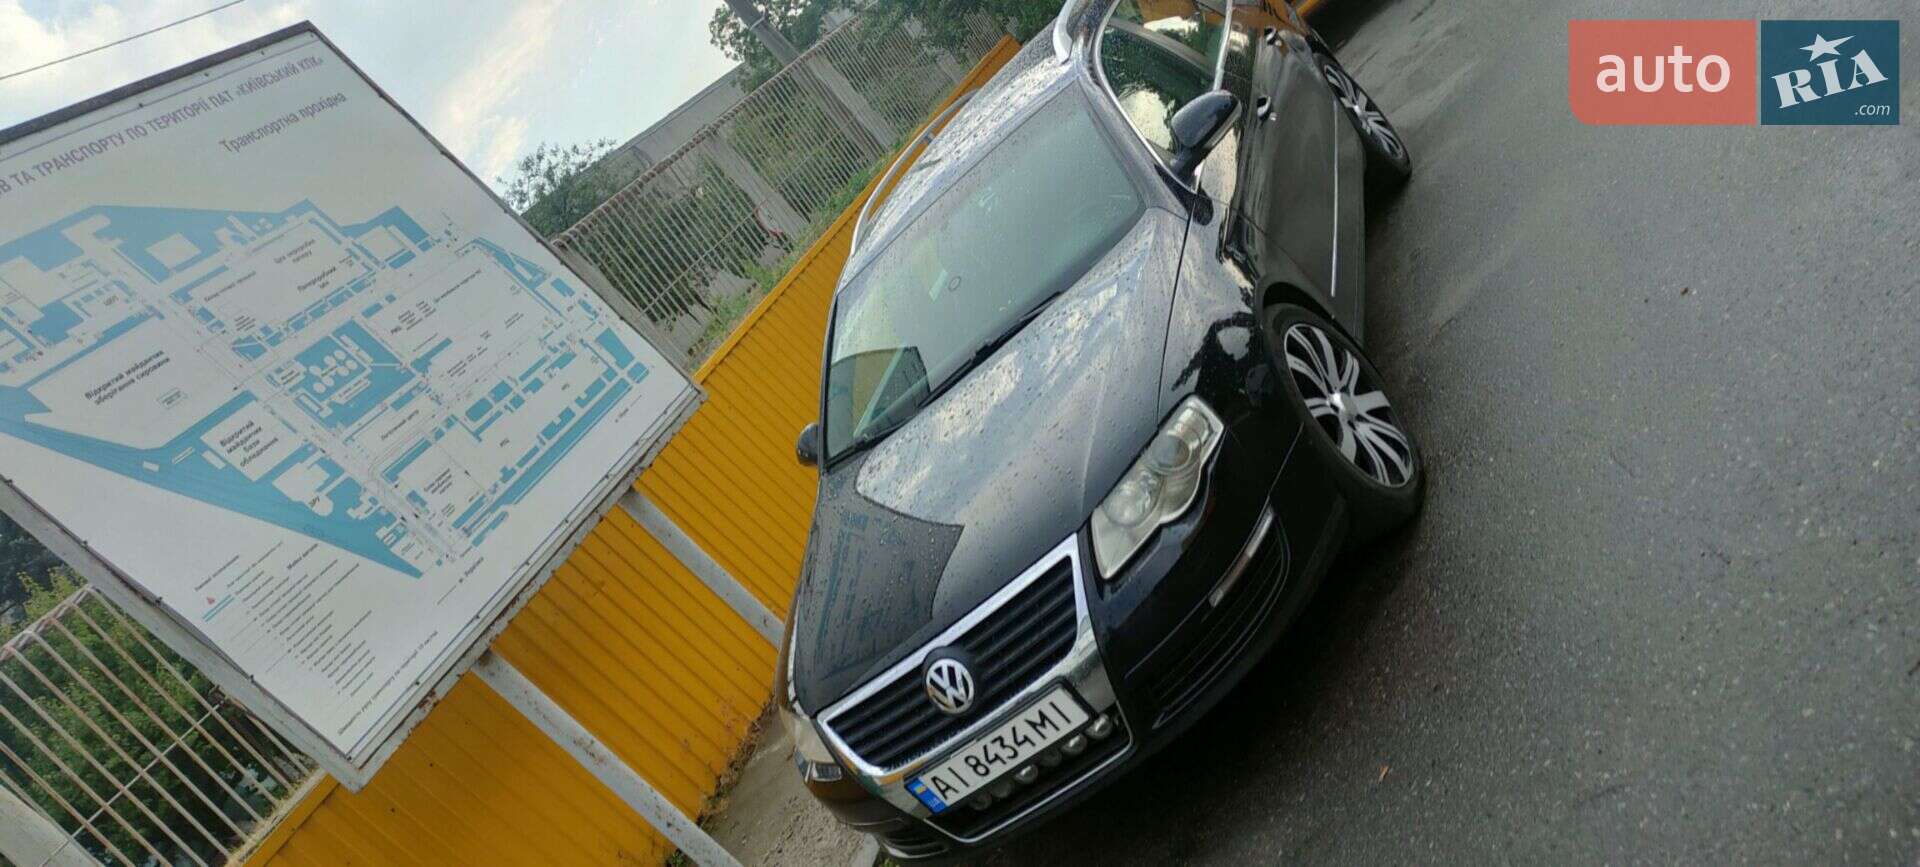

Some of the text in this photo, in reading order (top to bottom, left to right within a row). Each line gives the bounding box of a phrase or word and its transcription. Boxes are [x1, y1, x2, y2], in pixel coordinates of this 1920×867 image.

[9, 169, 36, 187] ТА
[31, 131, 125, 177] ТРАНСПОРТУ
[124, 124, 149, 142] ПО
[145, 97, 211, 134] ТЕРИТОРІЇ
[208, 90, 235, 110] ПАТ
[218, 92, 347, 153] Транспортна прохідна
[930, 766, 971, 801] AI
